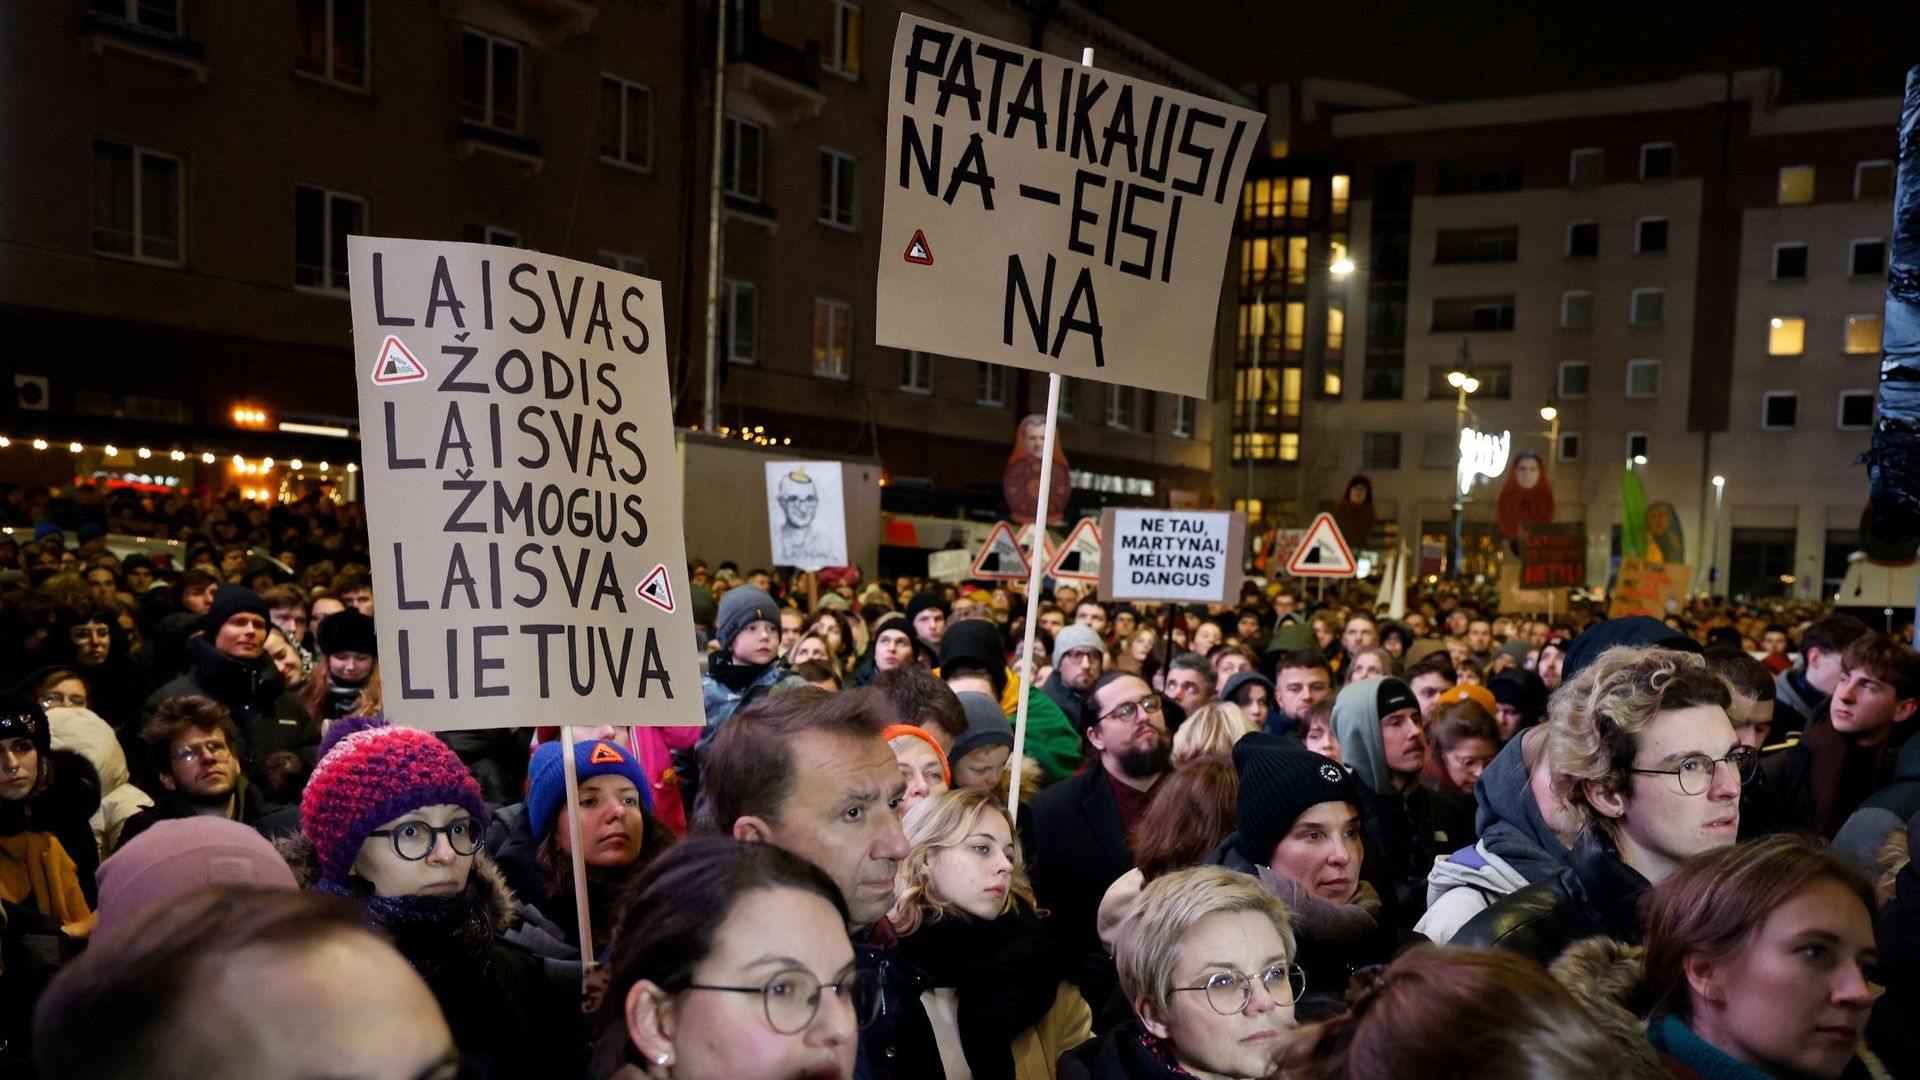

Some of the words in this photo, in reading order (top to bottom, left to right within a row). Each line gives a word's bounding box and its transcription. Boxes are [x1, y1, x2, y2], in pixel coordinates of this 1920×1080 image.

[905, 25, 1247, 204] PATAIKAUSI
[900, 115, 995, 210] NA
[1068, 169, 1182, 283] EISI
[373, 253, 649, 354] LAISVAS
[1004, 253, 1104, 367] NA
[438, 332, 622, 415] ŽODIS
[384, 401, 647, 485] LAISVAS
[443, 469, 647, 547] ŽMOGUS
[1121, 535, 1225, 555] MARTYNAI,
[1141, 518, 1164, 532] NE
[1169, 519, 1208, 537] TAU,
[394, 543, 627, 613] LAISVA
[1131, 571, 1210, 588] DANGUS
[398, 624, 674, 699] LIETUVA
